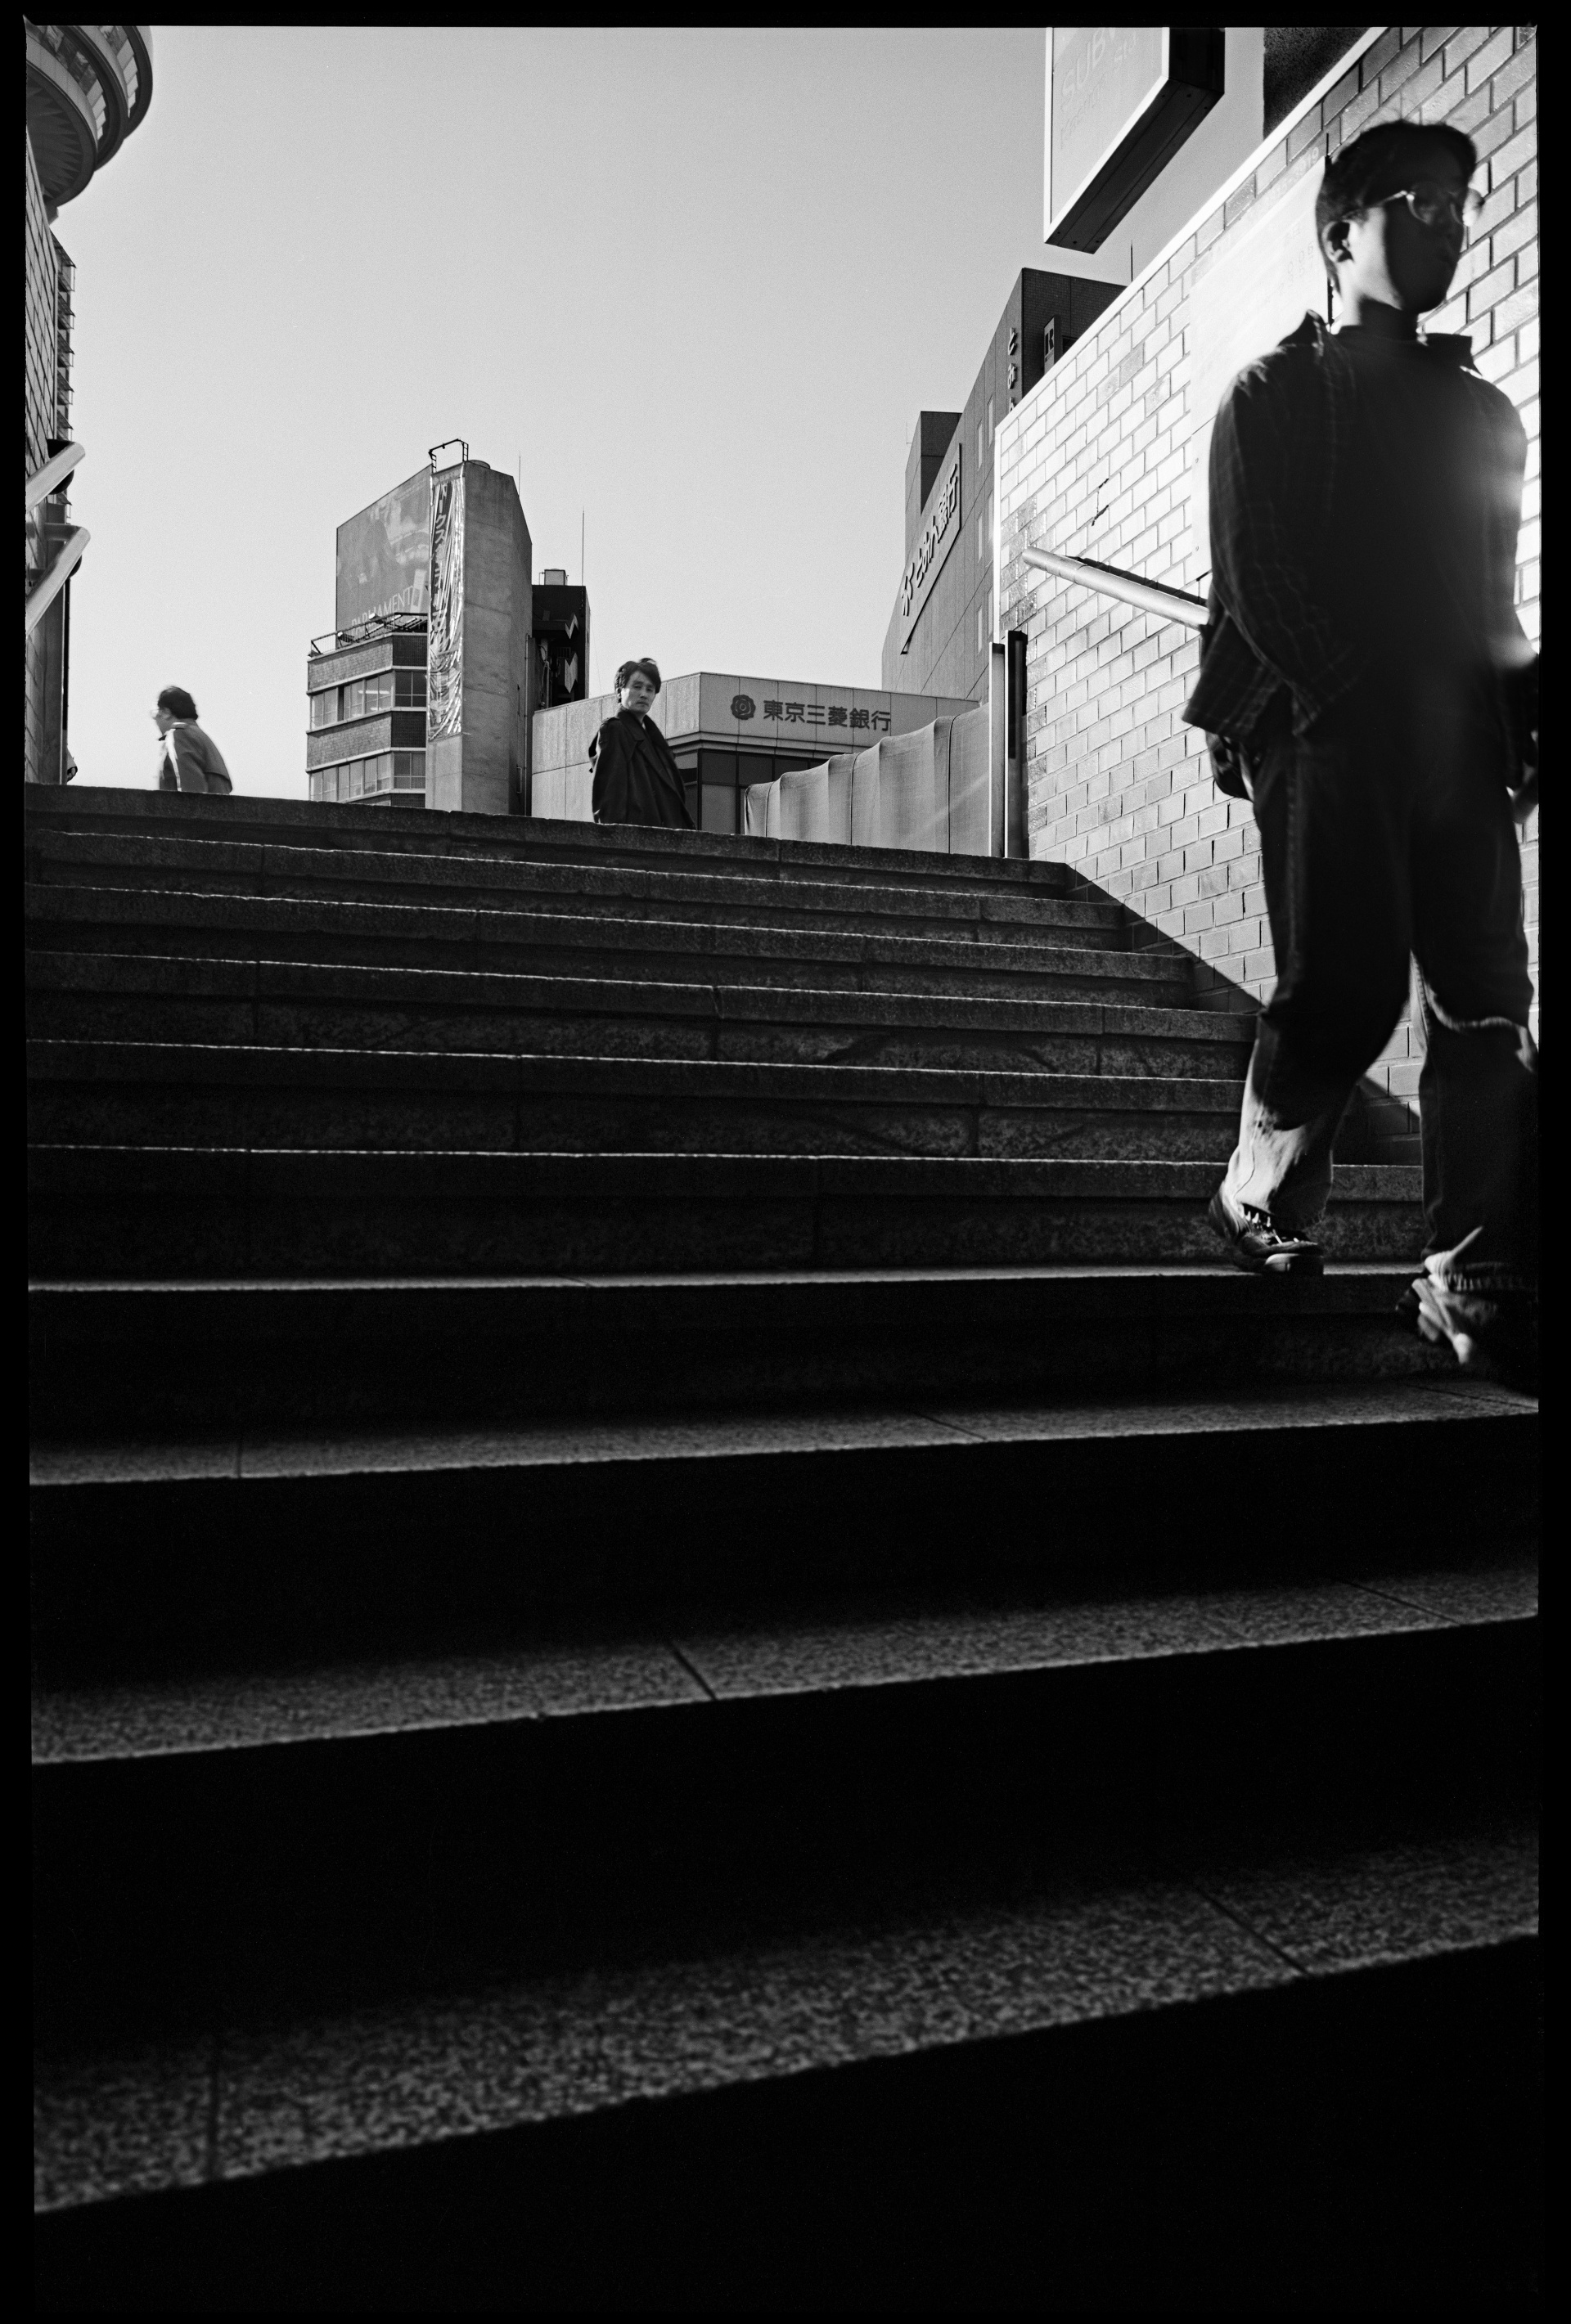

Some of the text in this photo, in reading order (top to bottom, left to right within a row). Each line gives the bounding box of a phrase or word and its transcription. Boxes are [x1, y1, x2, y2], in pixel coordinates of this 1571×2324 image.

[916, 463, 959, 588] とみん銀行
[763, 699, 891, 732] 東京三菱銀行
